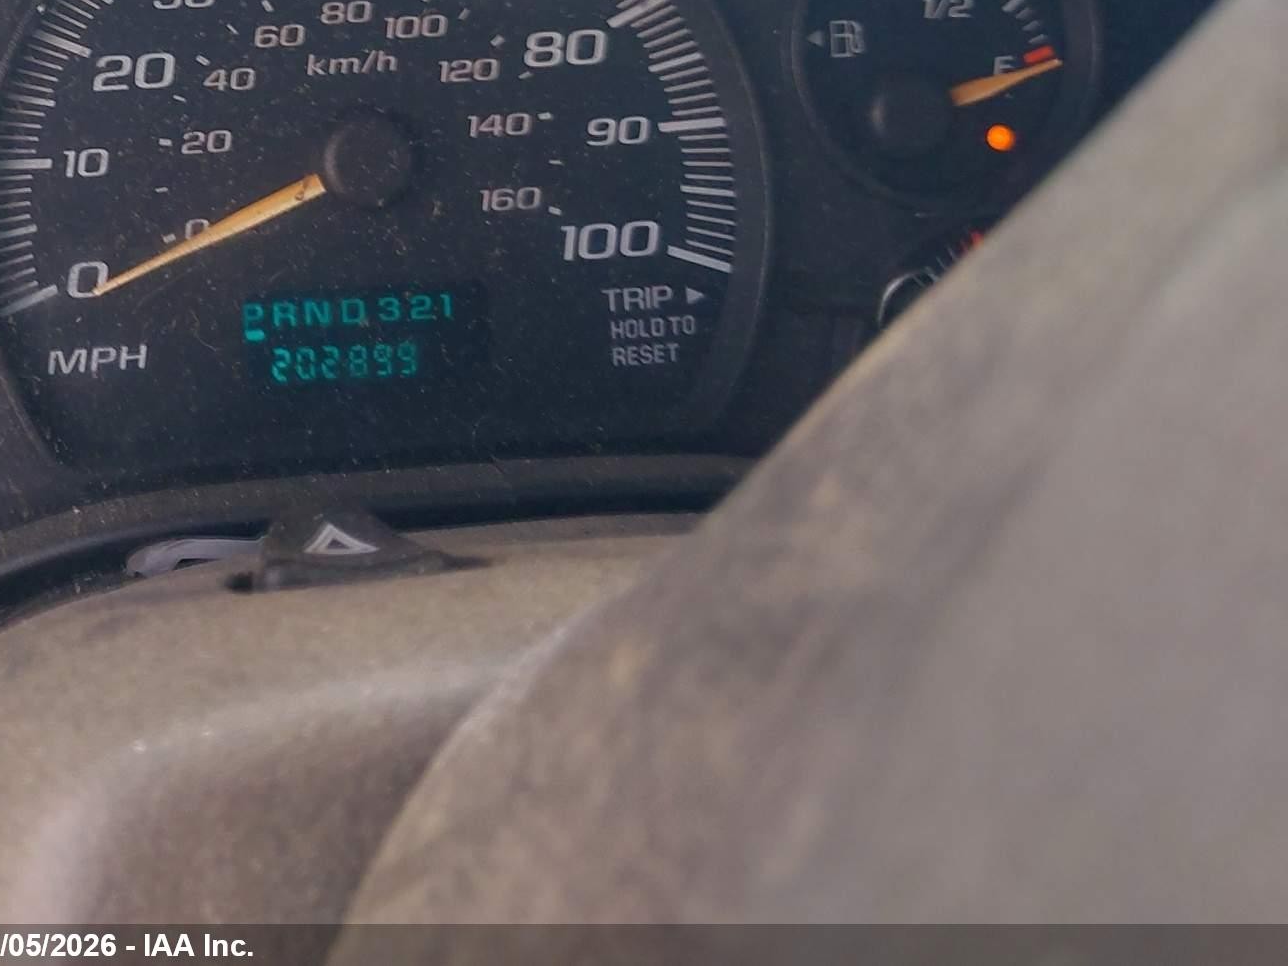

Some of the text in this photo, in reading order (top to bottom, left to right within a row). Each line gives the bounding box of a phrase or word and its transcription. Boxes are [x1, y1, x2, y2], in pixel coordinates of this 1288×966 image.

[320, 0, 372, 25] 80
[253, 24, 305, 48] 60
[384, 14, 448, 39] 100
[523, 28, 608, 68] 80
[92, 52, 176, 92] 20
[307, 50, 398, 76] km/h
[439, 58, 500, 83] 120
[203, 68, 256, 91] 40
[467, 113, 532, 138] 140
[586, 116, 650, 146] 90
[181, 130, 233, 154] 20
[63, 148, 109, 178] 10
[480, 187, 541, 212] 160
[561, 221, 660, 261] 100
[67, 261, 109, 298] 0
[602, 285, 673, 312] TRIP
[610, 315, 695, 338] HOLD TO
[48, 344, 148, 375] MPH
[271, 342, 417, 382] 202899
[613, 343, 679, 366] RESET
